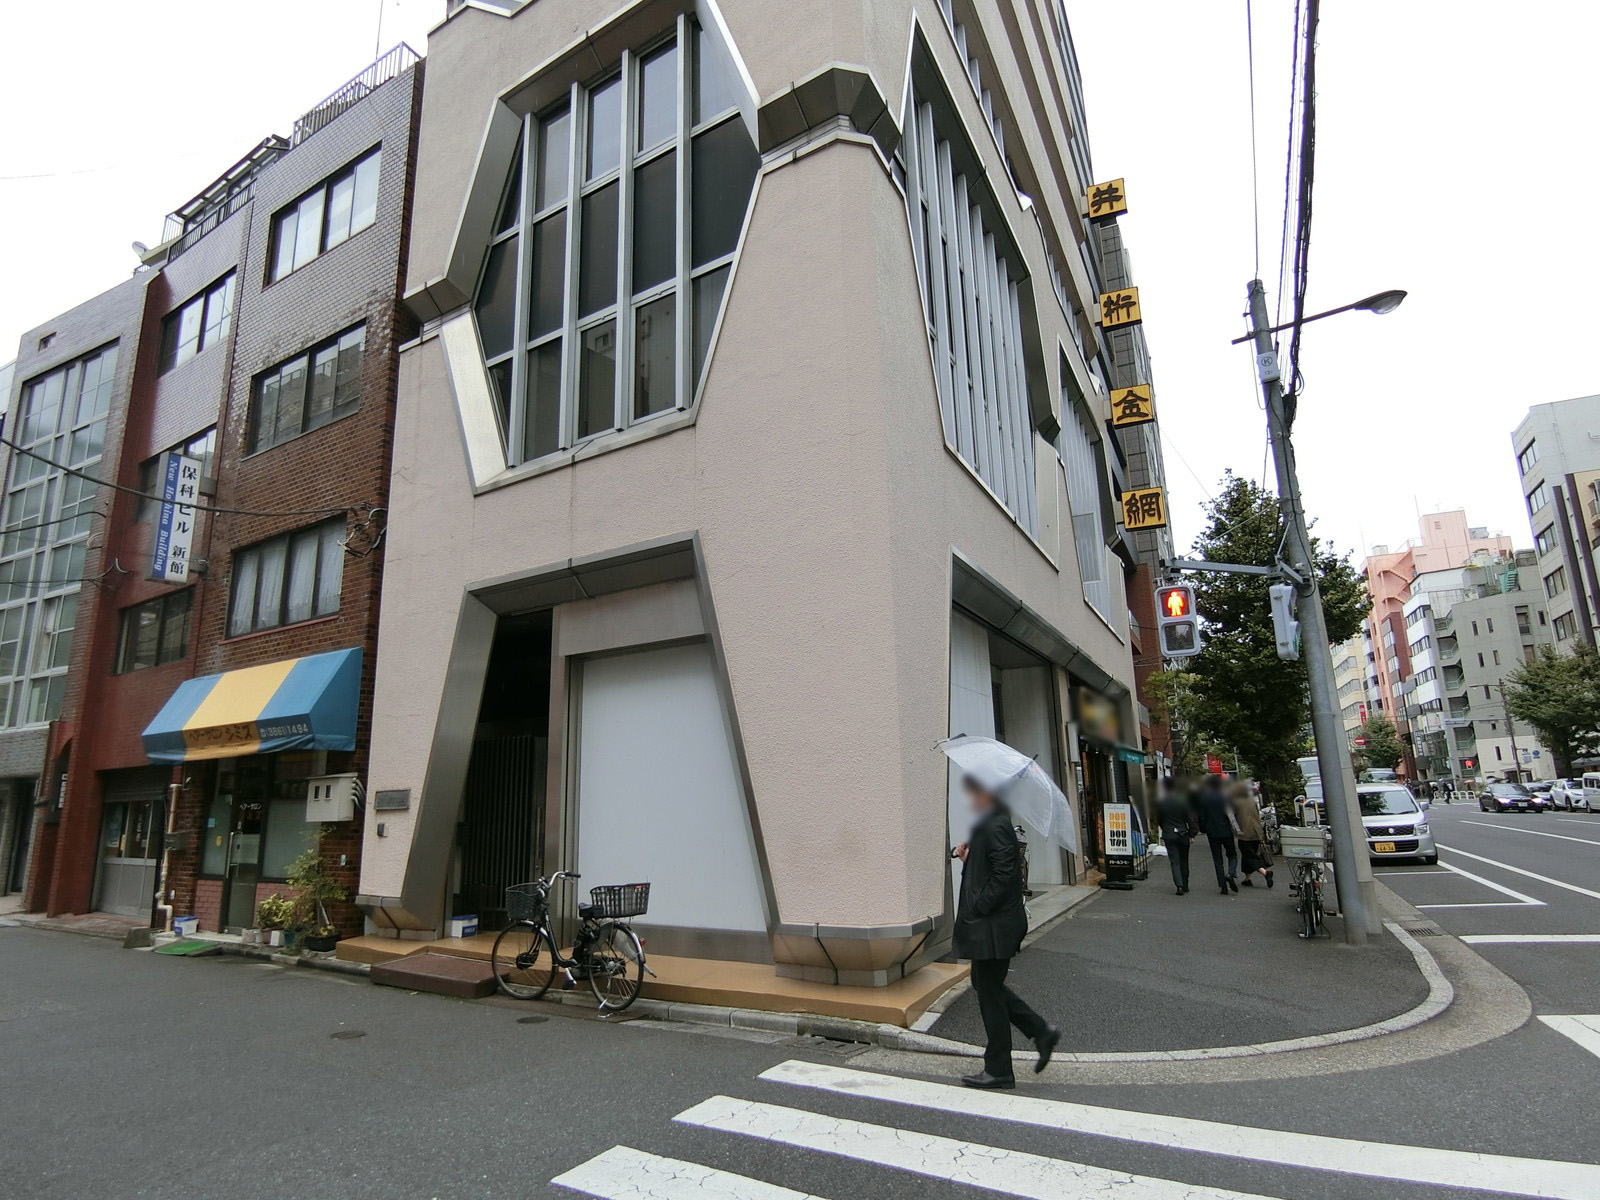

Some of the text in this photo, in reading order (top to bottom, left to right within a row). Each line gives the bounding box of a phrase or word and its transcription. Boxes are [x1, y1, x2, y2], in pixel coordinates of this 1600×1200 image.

[1113, 390, 1149, 422] 金
[154, 460, 178, 571] New Hohina Building
[170, 465, 197, 575] 保科ビル 新館
[1109, 830, 1127, 838] DOU
